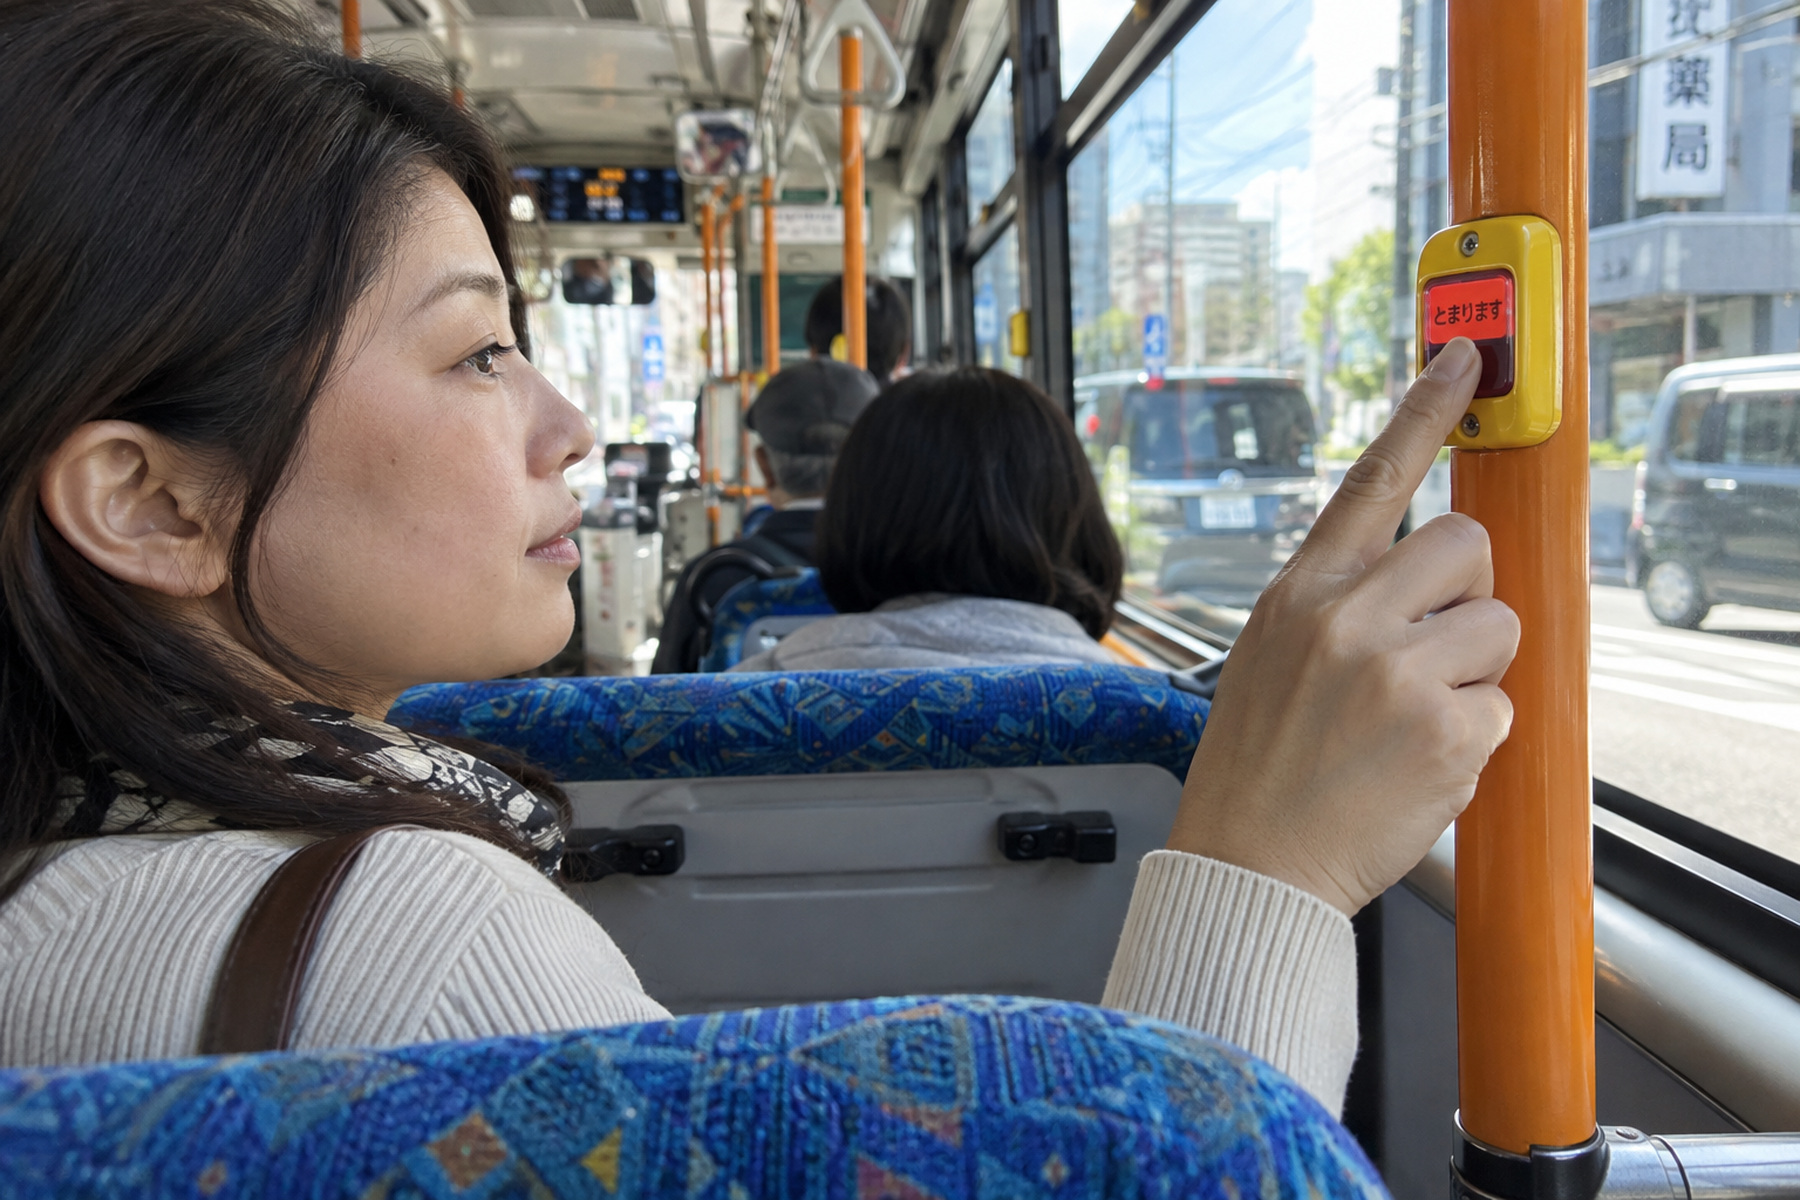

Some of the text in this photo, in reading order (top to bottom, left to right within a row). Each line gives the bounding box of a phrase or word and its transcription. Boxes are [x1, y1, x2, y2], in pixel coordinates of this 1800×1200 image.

[1434, 299, 1503, 326] とまります
